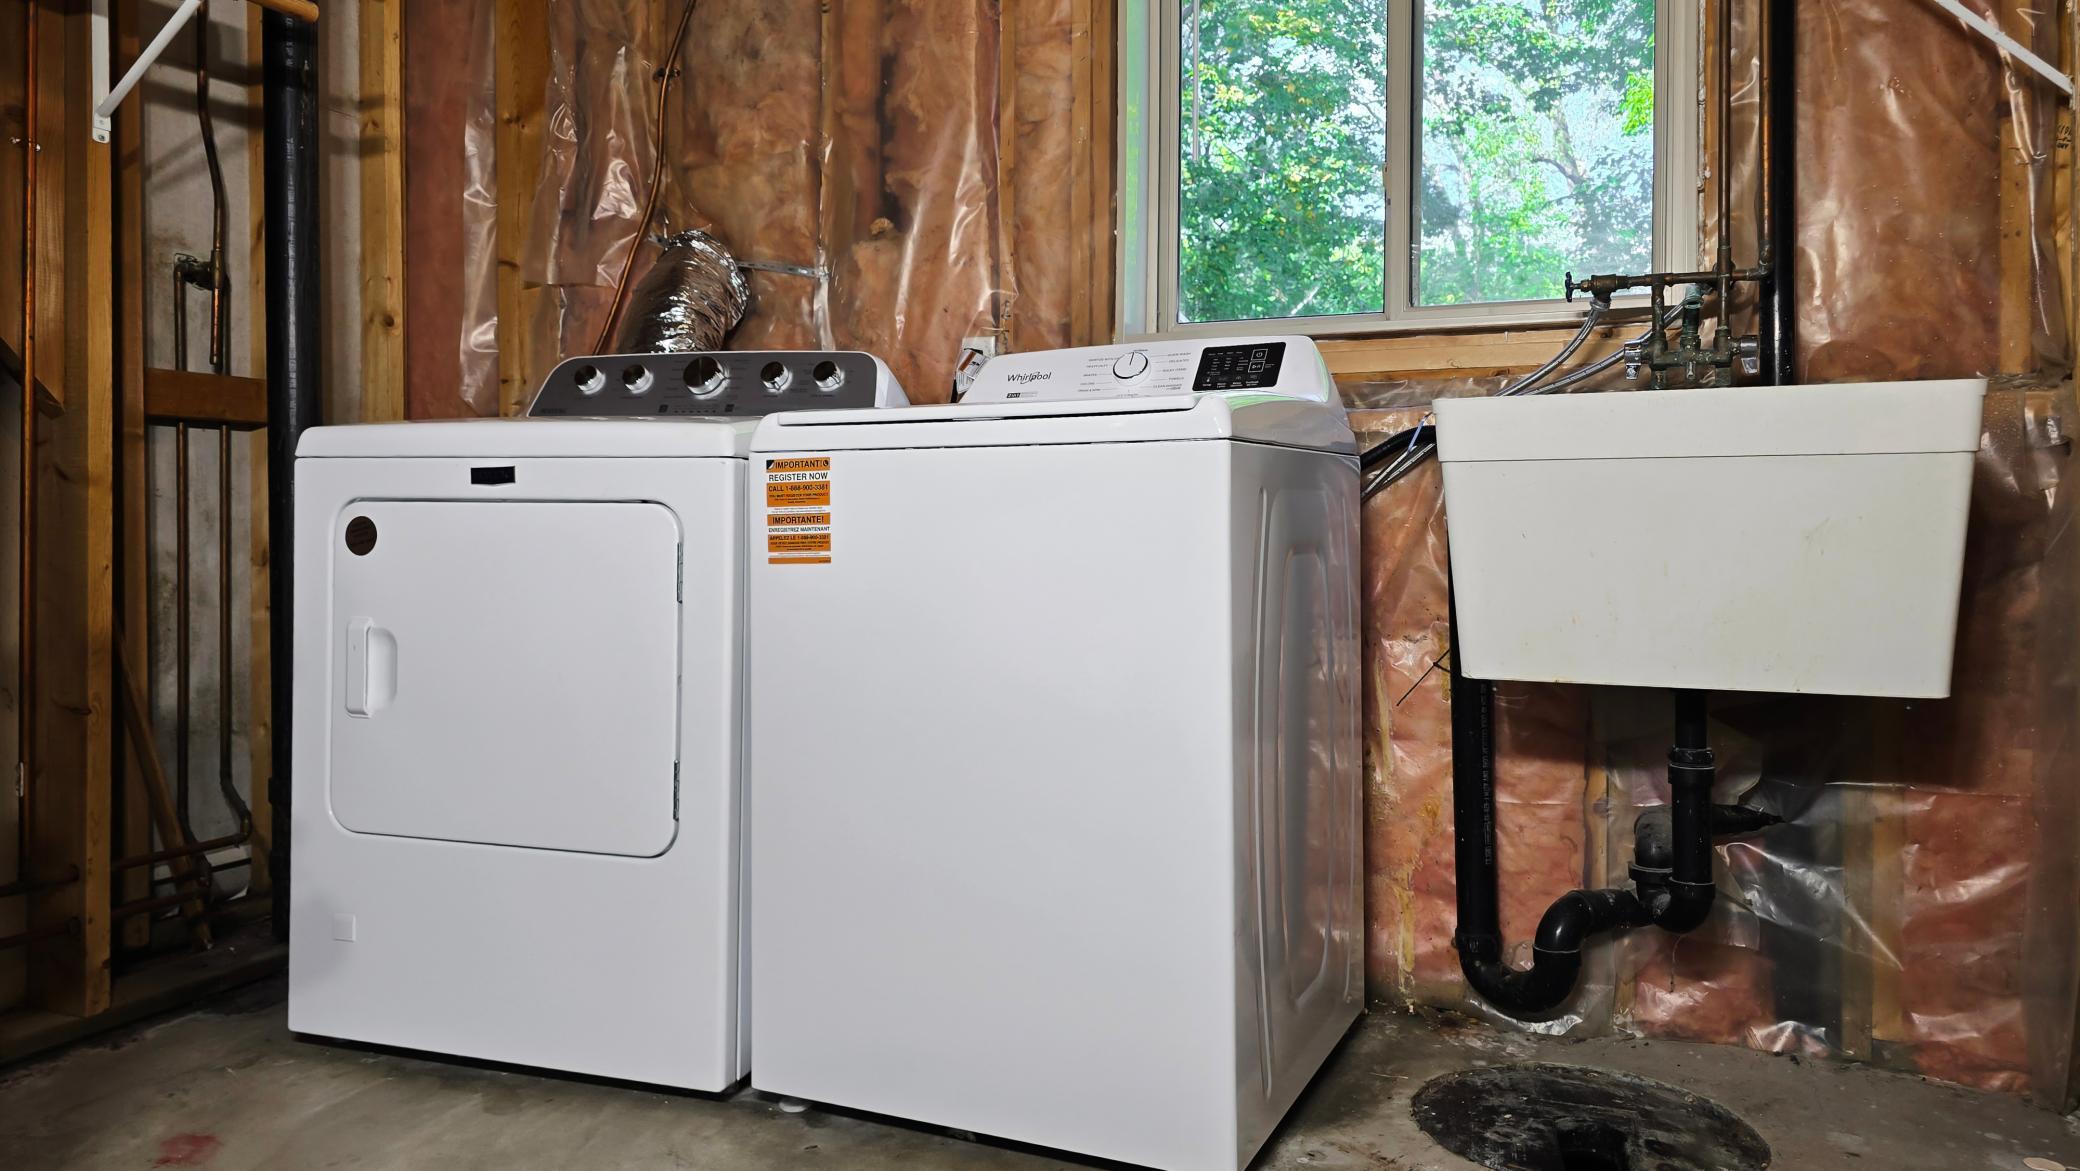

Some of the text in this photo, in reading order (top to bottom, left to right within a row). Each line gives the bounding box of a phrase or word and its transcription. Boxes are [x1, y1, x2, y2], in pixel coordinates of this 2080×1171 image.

[1007, 371, 1052, 384] Whirlpool
[775, 460, 822, 469] IMPORTANT!
[769, 472, 828, 482] REGISTER NOW
